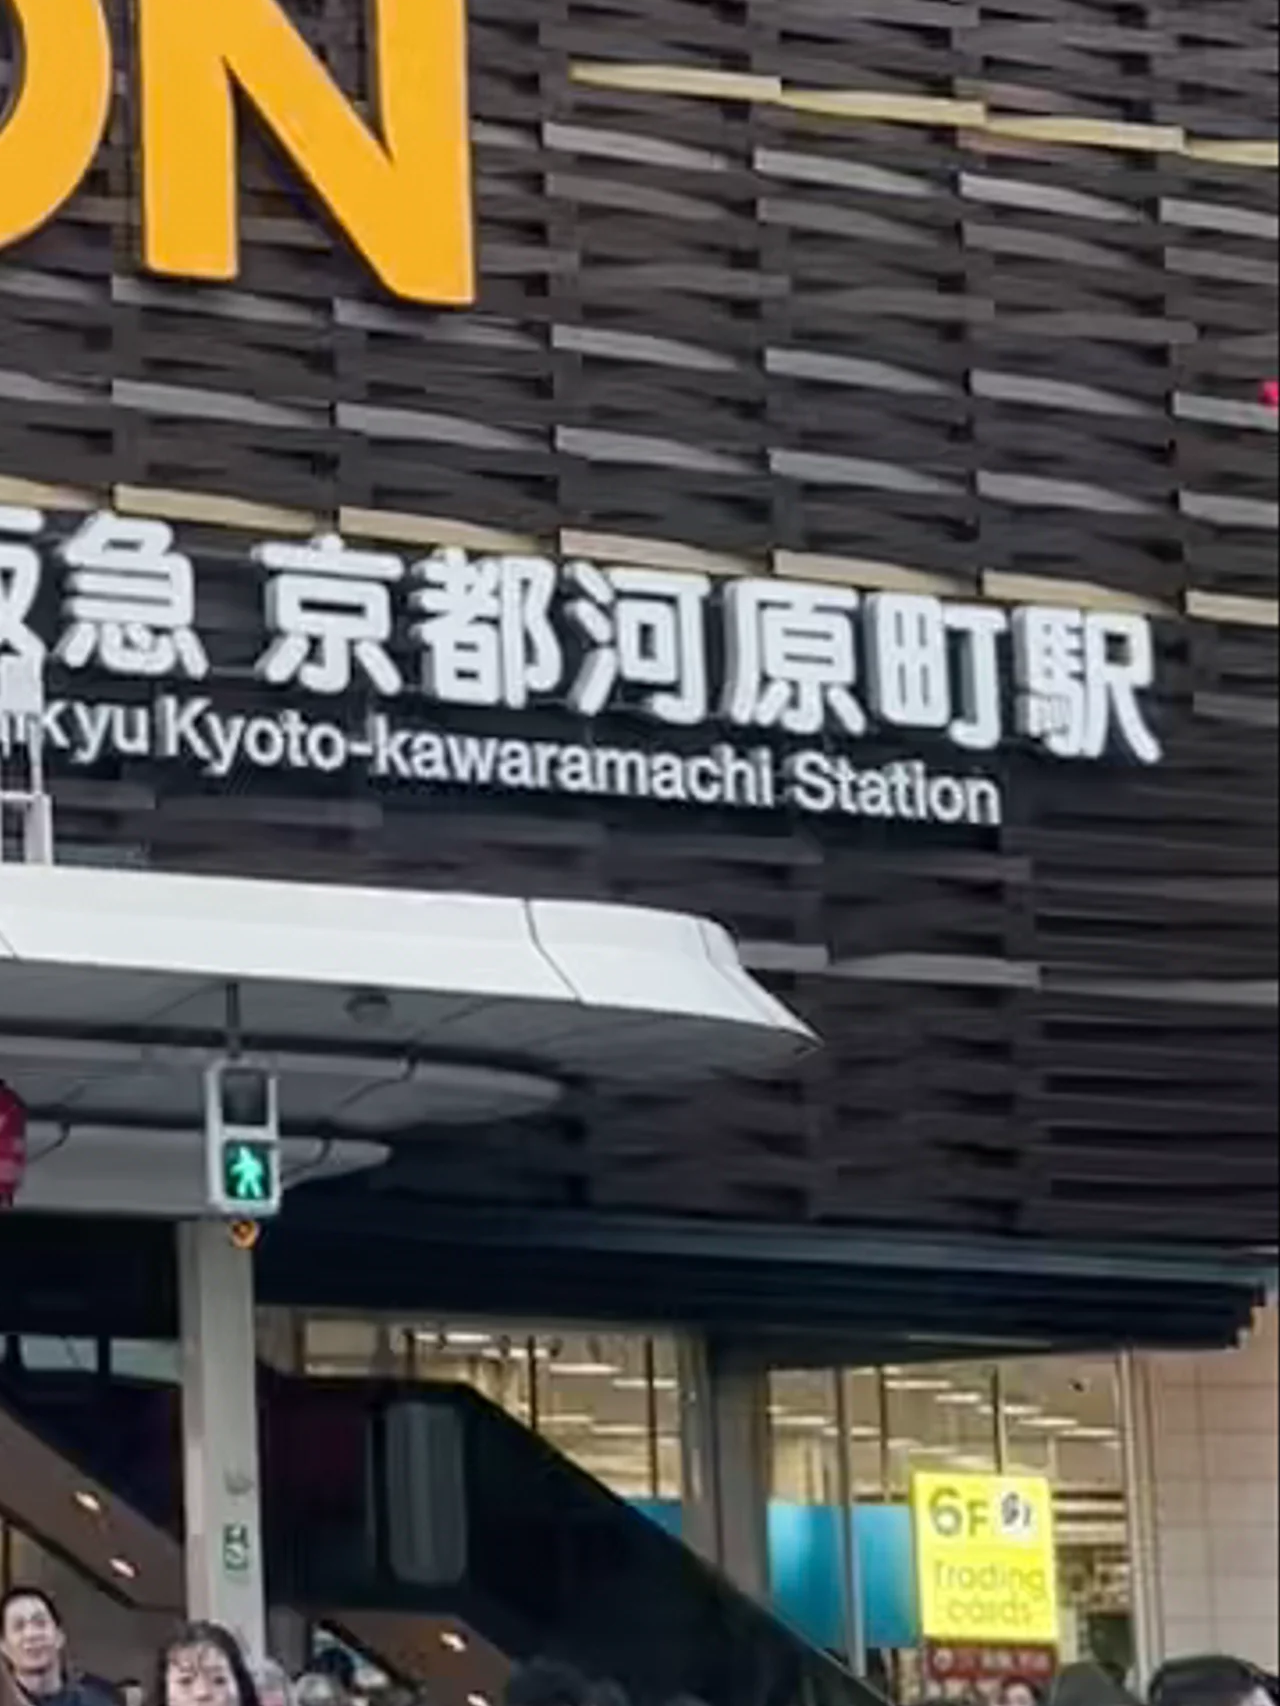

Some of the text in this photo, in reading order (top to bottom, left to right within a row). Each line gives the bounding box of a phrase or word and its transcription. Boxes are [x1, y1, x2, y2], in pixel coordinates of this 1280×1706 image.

[250, 532, 1164, 765] 京都河原町駅
[156, 693, 774, 808] Kyoto-kawaramachi
[791, 751, 1003, 826] Station
[928, 1485, 989, 1537] 6F
[934, 1560, 1049, 1603] Trading
